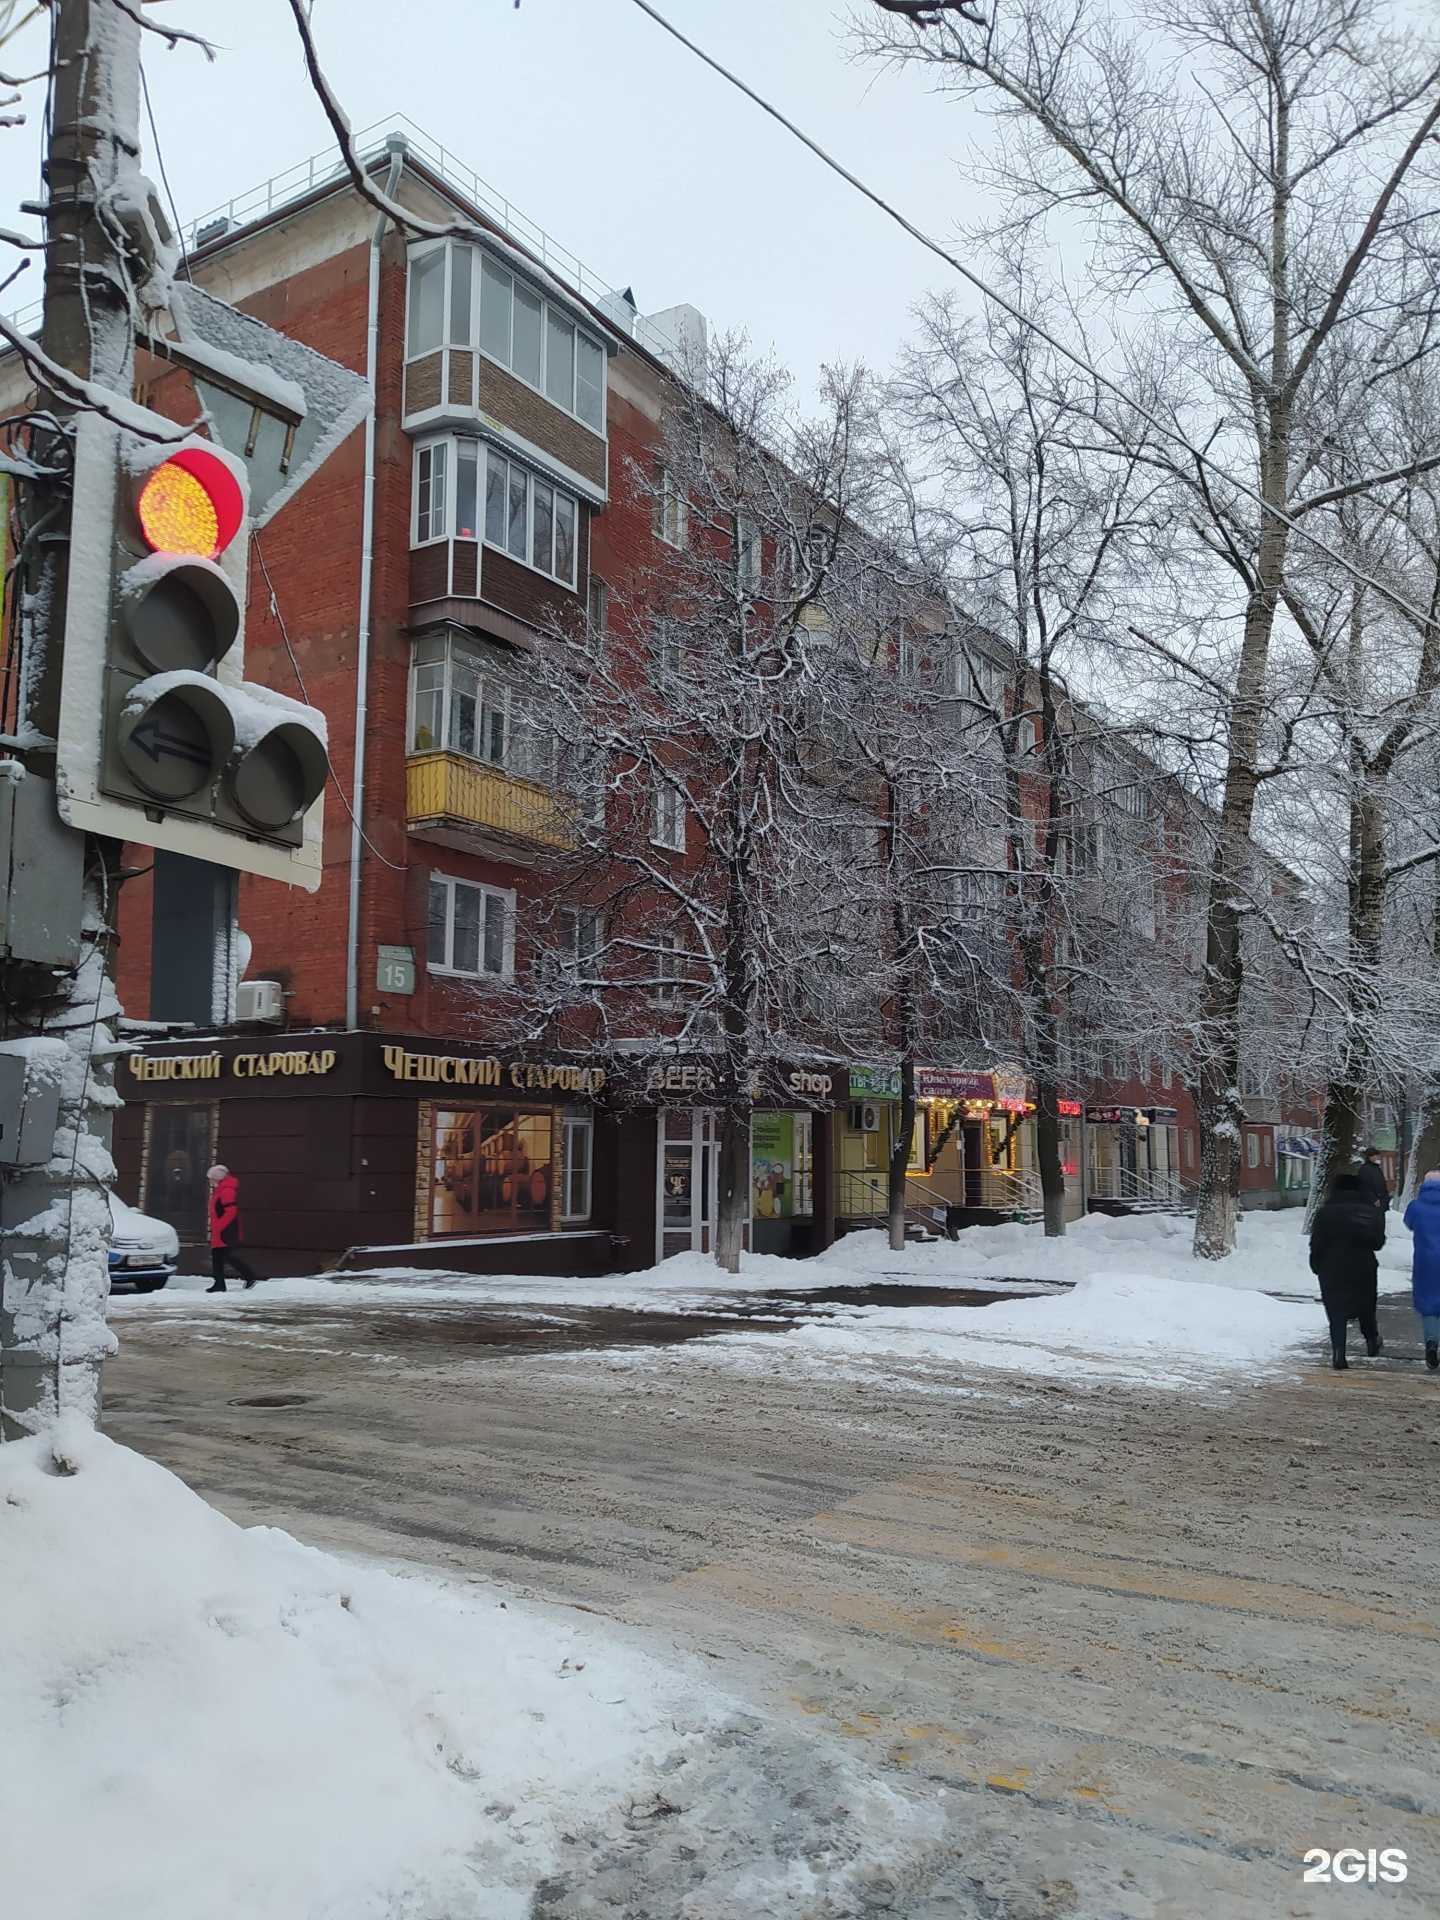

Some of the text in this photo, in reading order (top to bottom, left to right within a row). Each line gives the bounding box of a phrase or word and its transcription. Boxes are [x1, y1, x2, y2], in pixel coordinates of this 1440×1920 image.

[385, 964, 405, 987] 15
[128, 1050, 336, 1080] ЧЕШСКИЙ СТАРОВАР
[381, 1045, 501, 1087] ЧЕШСКИЙ
[789, 1069, 832, 1098] shop
